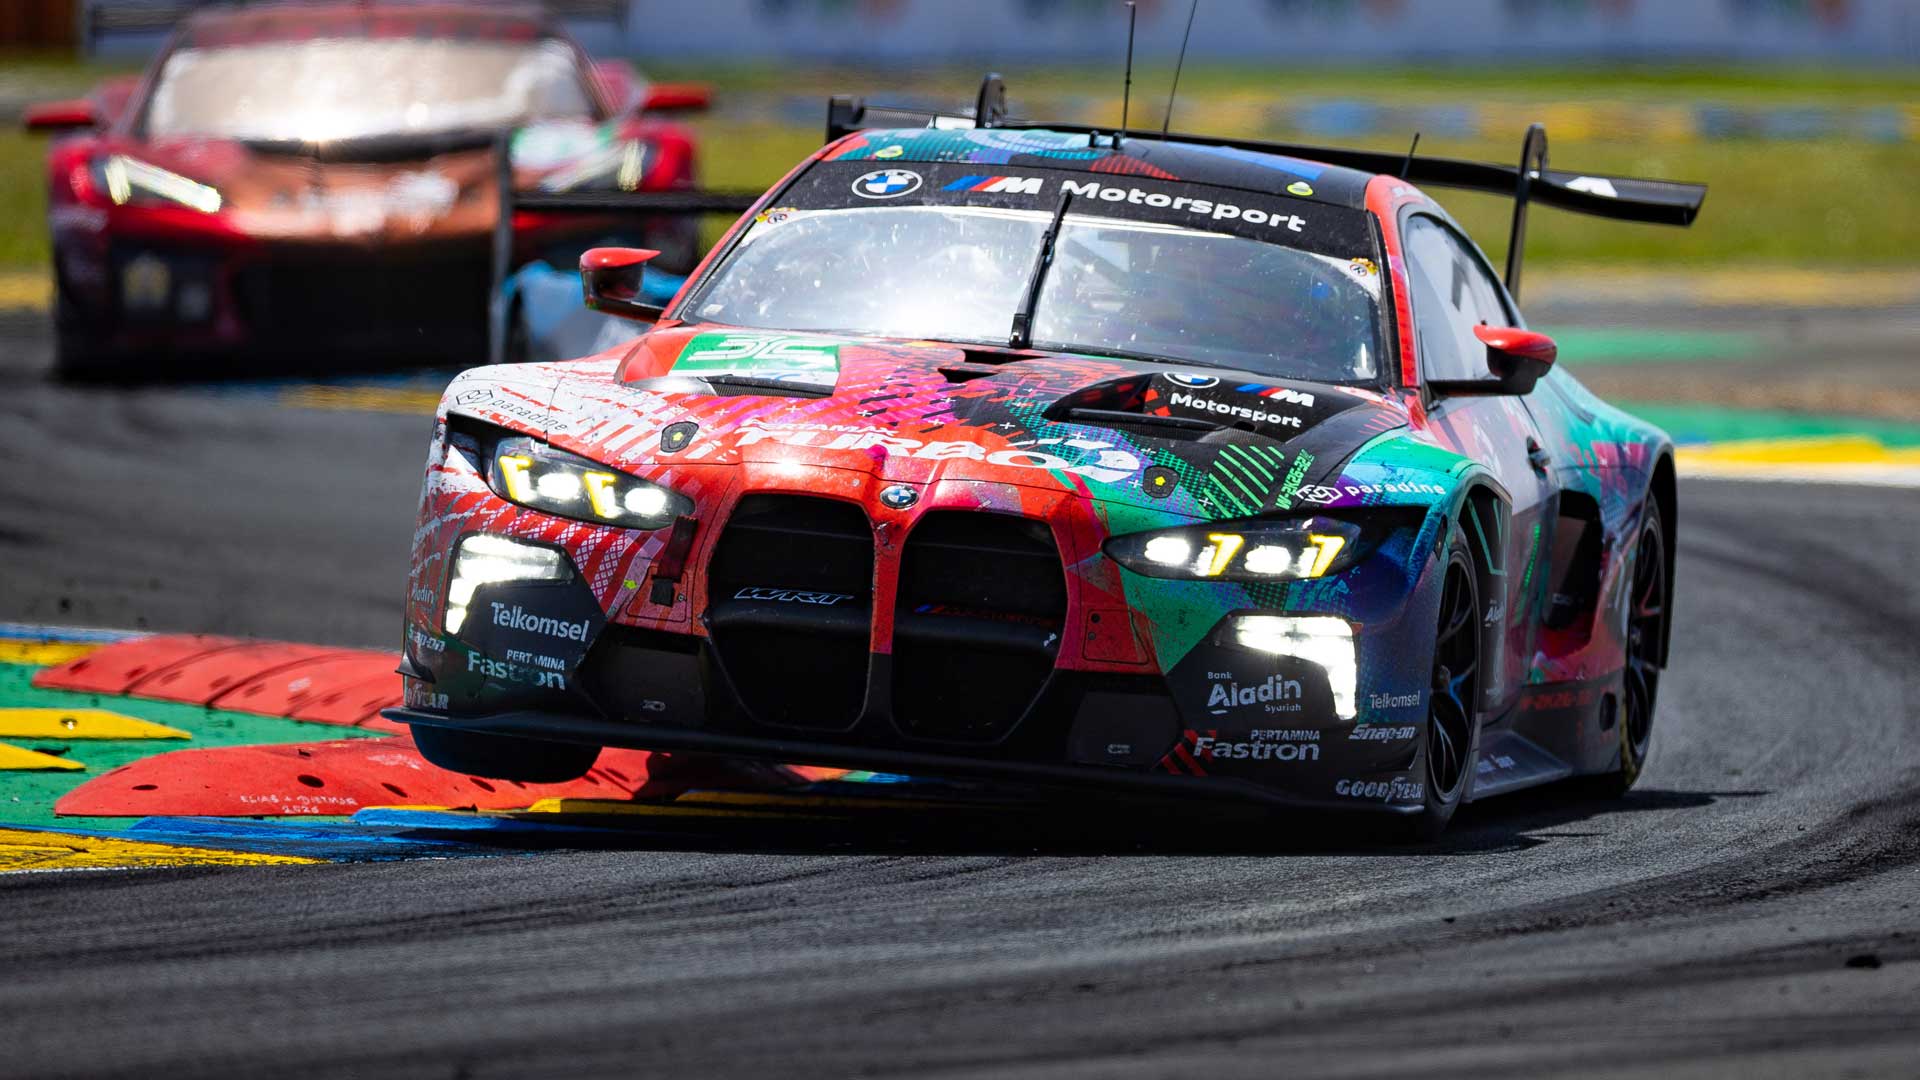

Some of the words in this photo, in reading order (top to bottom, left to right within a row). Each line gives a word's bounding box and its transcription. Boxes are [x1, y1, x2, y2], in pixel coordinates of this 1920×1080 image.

[981, 176, 1044, 195] M
[1059, 180, 1306, 232] Motorsport
[1270, 388, 1315, 408] M
[1170, 393, 1302, 428] Motorsport
[1344, 480, 1447, 497] paradine
[490, 602, 589, 642] Telkomsel
[1207, 671, 1232, 680] Bank
[1207, 674, 1302, 708] Aladin
[1369, 690, 1421, 709] Telkomsel
[1250, 729, 1321, 741] PERTAMINA
[1348, 723, 1417, 744] Snap-on
[1193, 736, 1320, 761] Fastron
[1335, 777, 1424, 802] GOODYEAR
